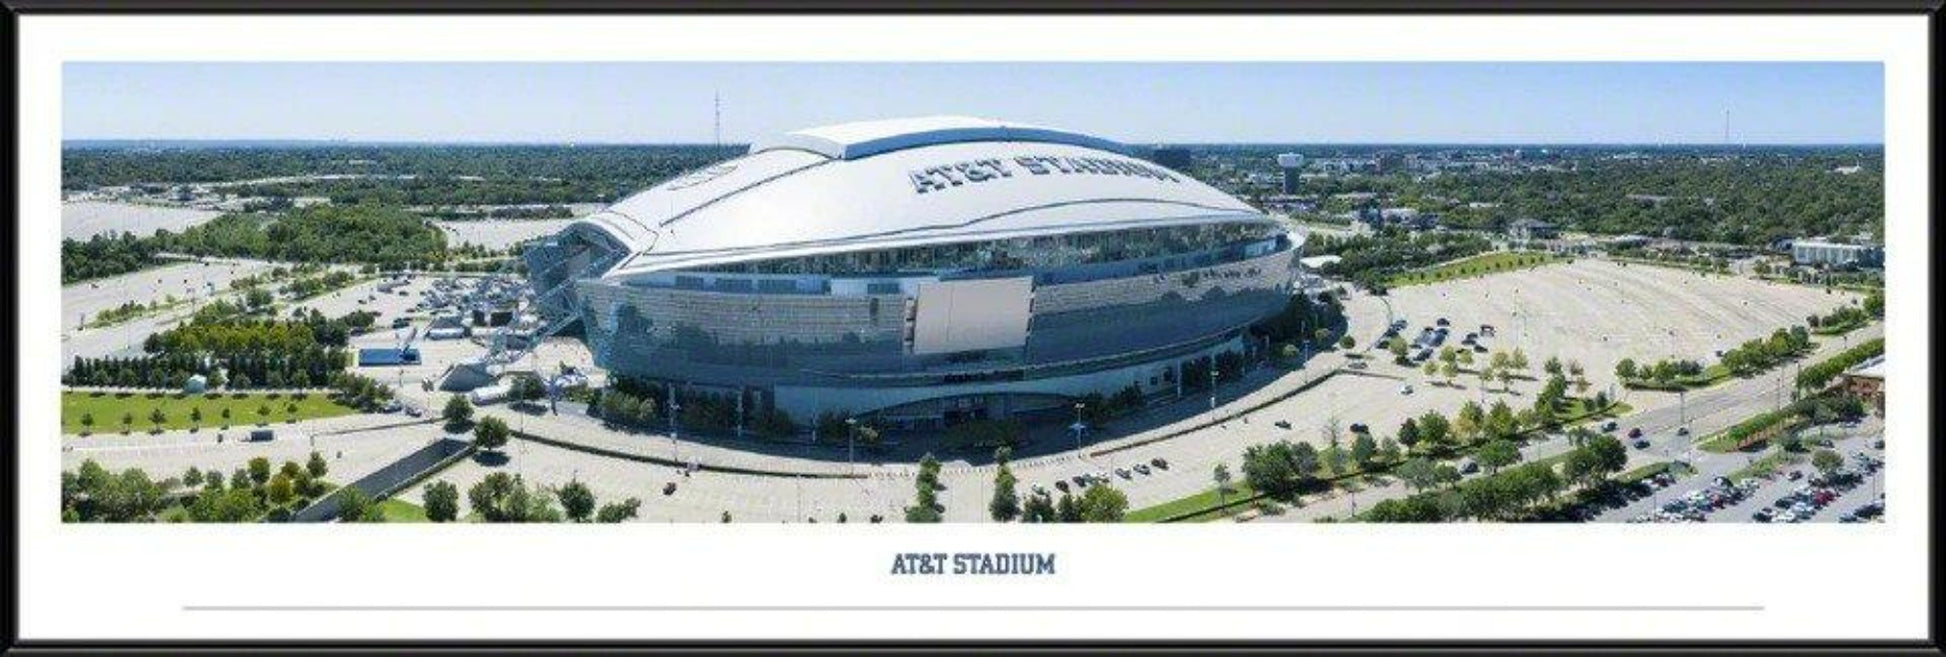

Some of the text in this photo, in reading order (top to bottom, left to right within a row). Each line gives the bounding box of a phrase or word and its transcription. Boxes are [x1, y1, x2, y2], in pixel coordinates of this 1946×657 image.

[909, 158, 1012, 193] AT&T
[891, 553, 1055, 574] AT&T STADIUM
